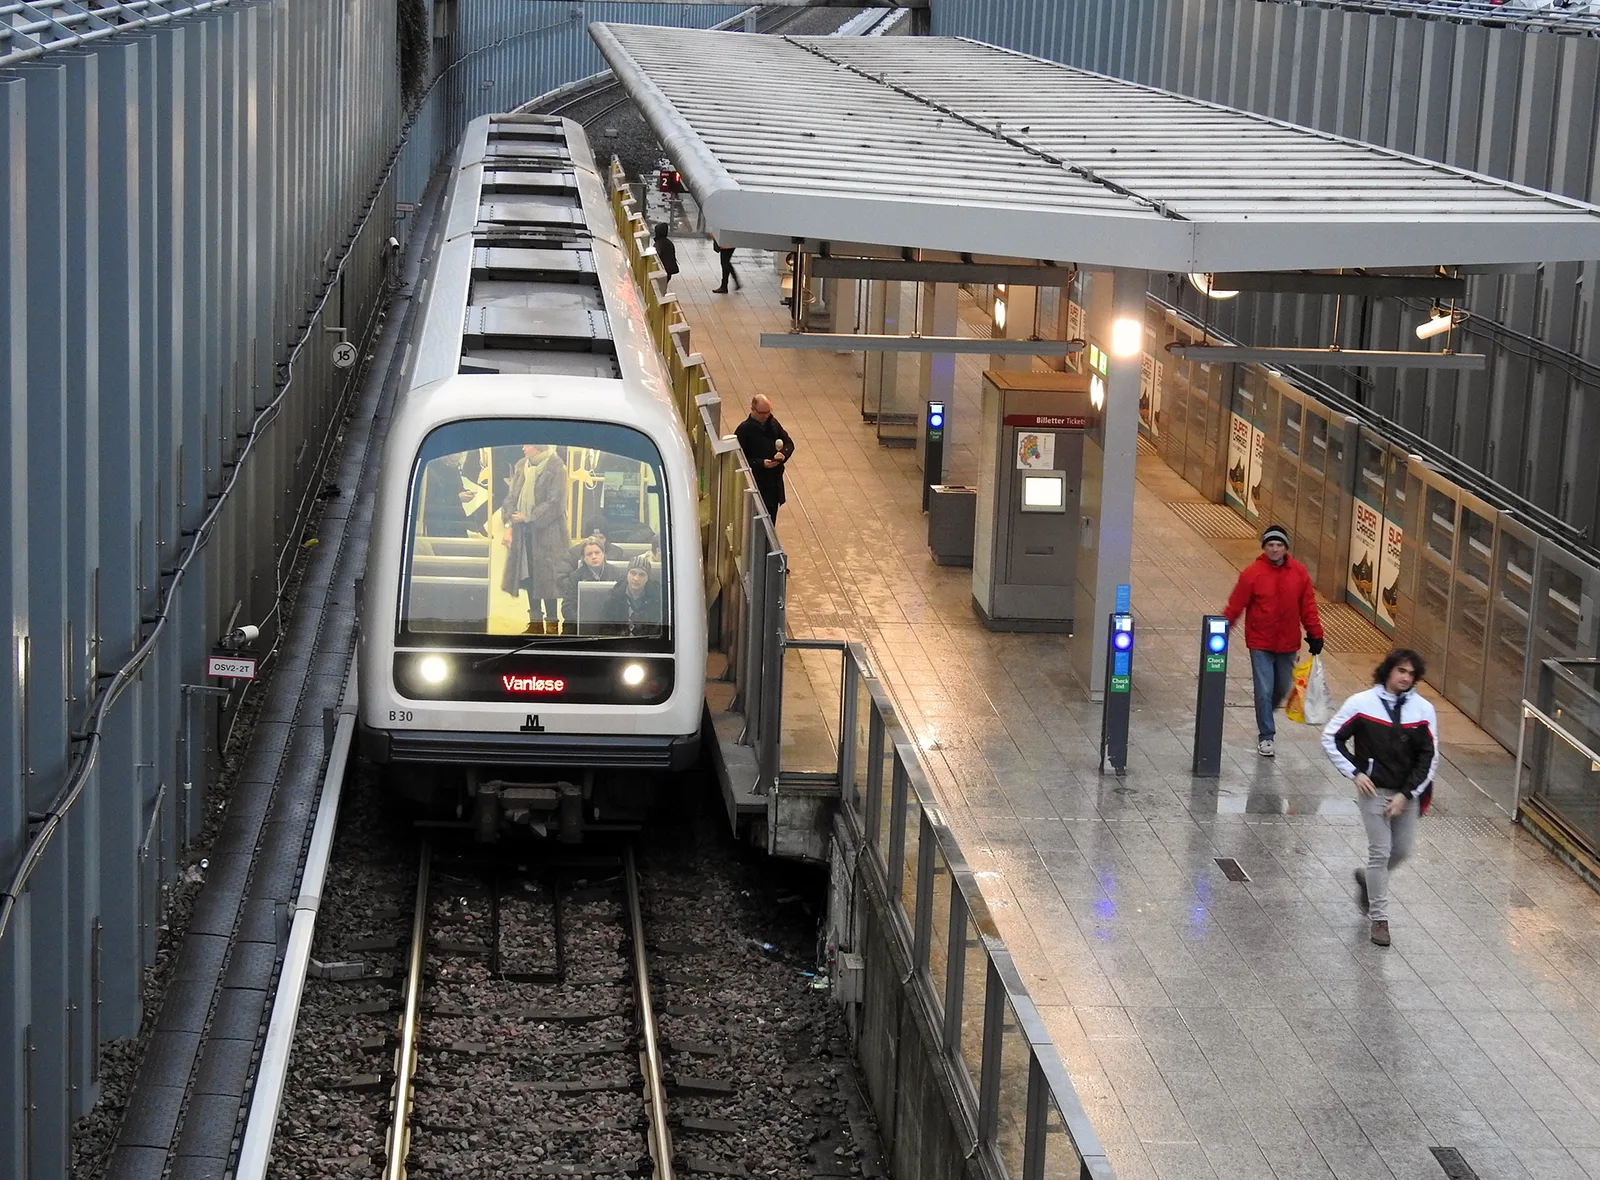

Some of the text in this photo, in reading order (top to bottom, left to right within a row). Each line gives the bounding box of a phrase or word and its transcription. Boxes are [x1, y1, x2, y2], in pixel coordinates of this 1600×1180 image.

[662, 177, 668, 186] 2
[337, 350, 350, 361] 15
[1036, 416, 1065, 425] Billetter
[1233, 417, 1248, 438] SUPER
[1357, 504, 1377, 530] SUPER
[1356, 520, 1376, 543] CHARGED
[1388, 526, 1403, 546] SUP
[213, 663, 250, 673] OSV2-2T
[502, 675, 564, 691] Vanløse
[389, 710, 414, 722] B 30
